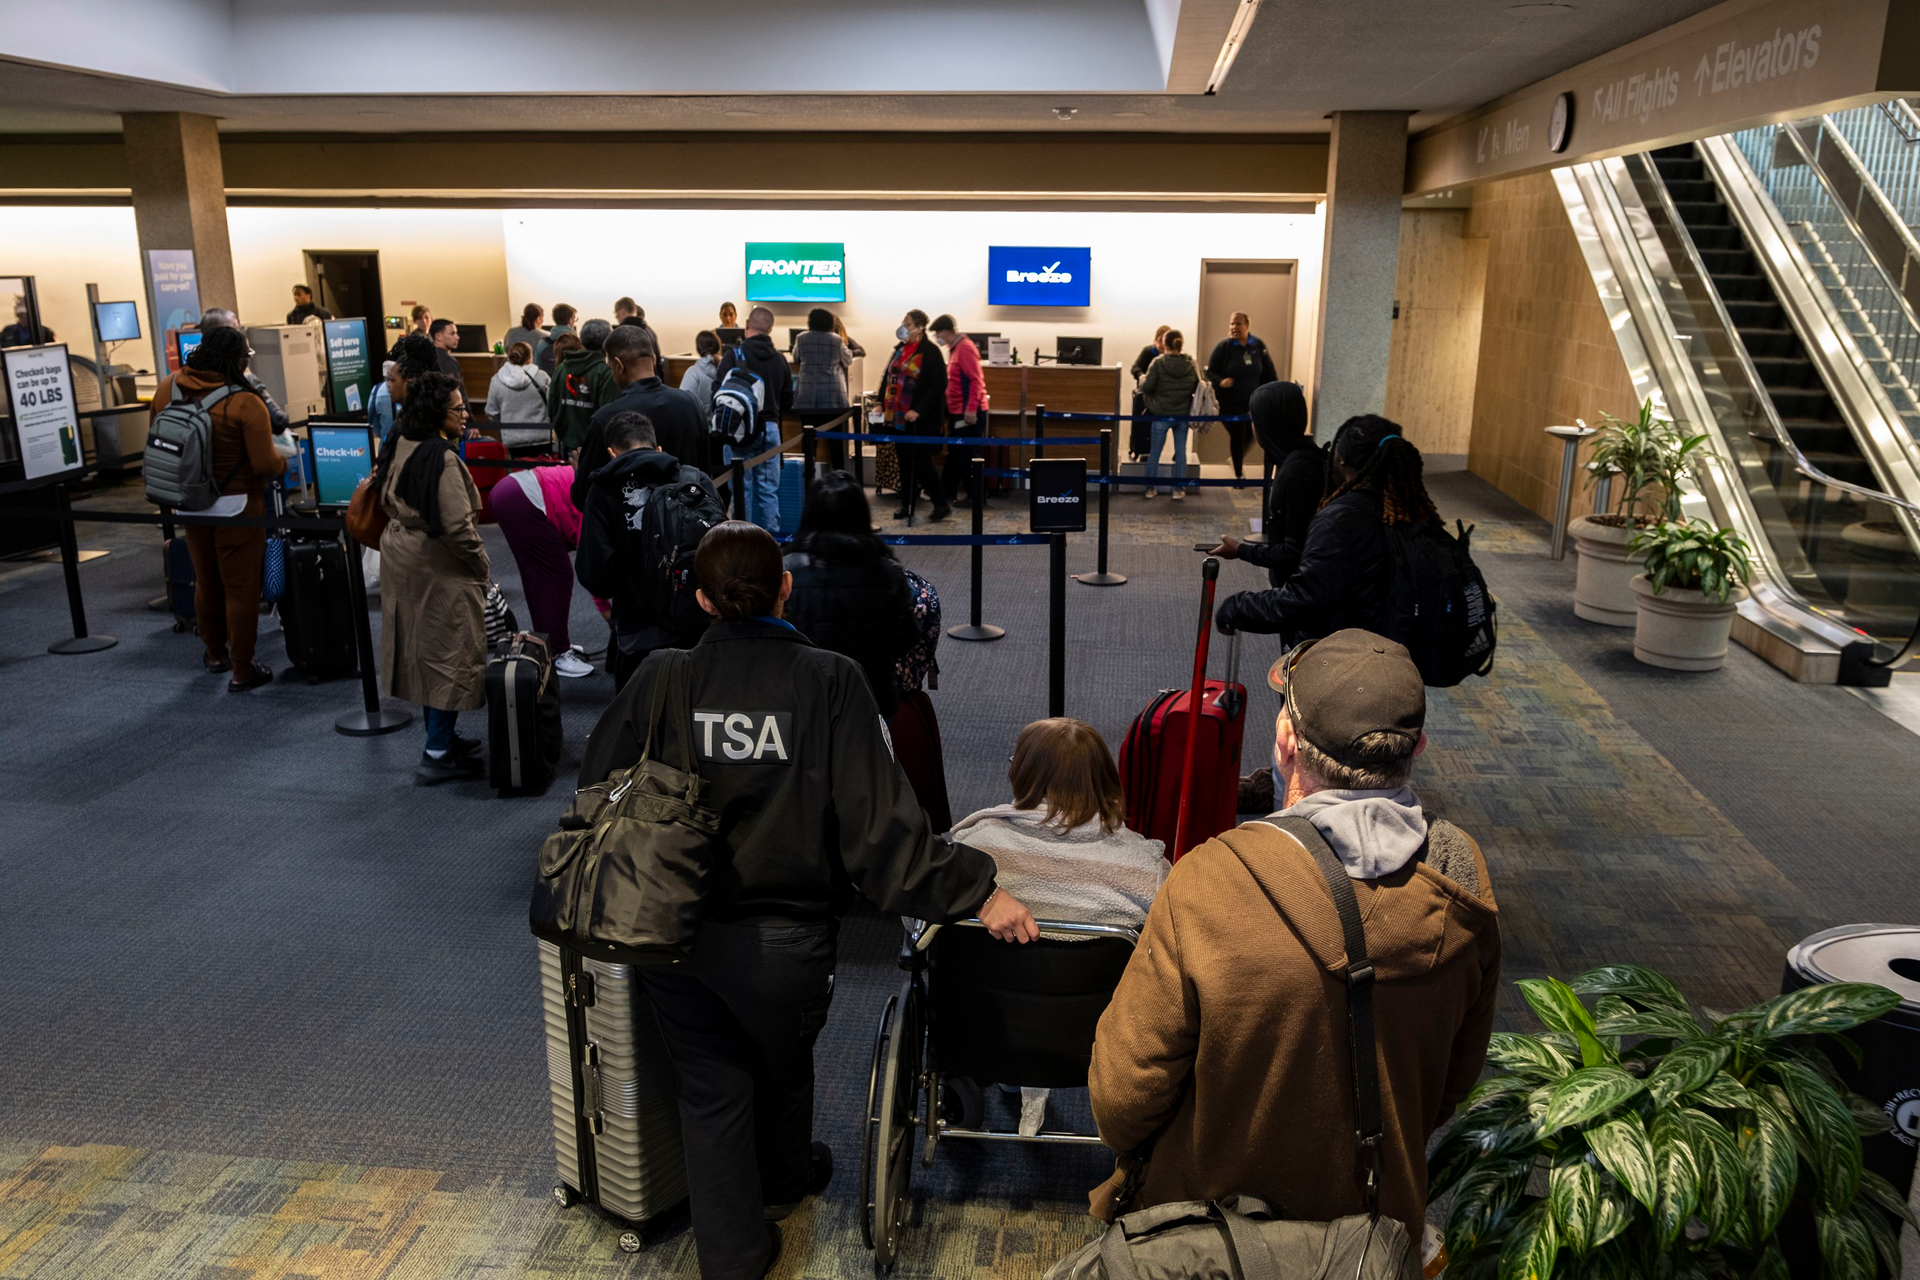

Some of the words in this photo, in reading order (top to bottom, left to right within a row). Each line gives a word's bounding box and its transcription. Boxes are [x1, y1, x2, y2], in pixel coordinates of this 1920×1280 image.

[1711, 24, 1822, 93] Elevators
[1602, 83, 1624, 124] All
[1624, 66, 1679, 125] Flights
[1505, 119, 1530, 155] Men
[748, 259, 842, 275] FRONTIER
[1006, 269, 1072, 283] Breeze
[330, 337, 342, 348] Self
[343, 337, 360, 347] serve
[331, 348, 344, 358] and
[344, 346, 360, 357] save!
[15, 366, 44, 379] Checked
[45, 365, 62, 375] bags
[17, 380, 29, 389] can
[30, 379, 39, 387] be
[41, 378, 49, 387] up
[50, 376, 58, 384] to
[20, 391, 37, 408] 40
[39, 387, 63, 405] LBS
[316, 447, 360, 457] Check-in
[1037, 495, 1080, 504] Breeze
[694, 712, 788, 760] TSA
